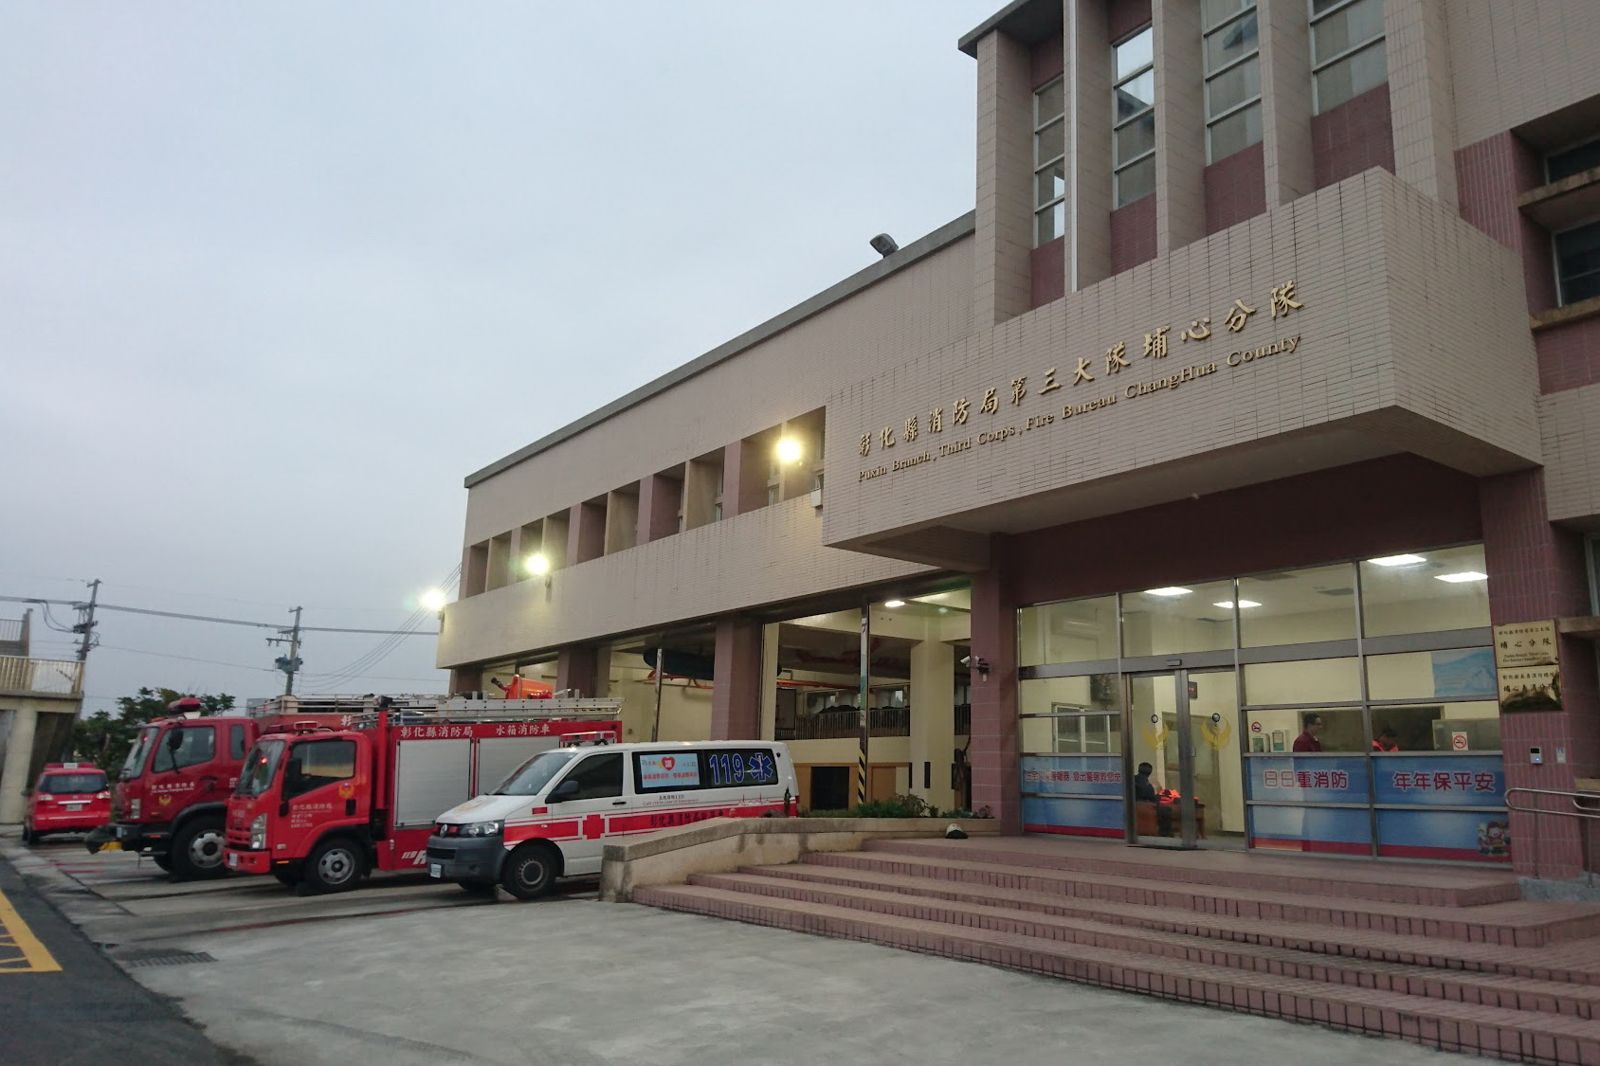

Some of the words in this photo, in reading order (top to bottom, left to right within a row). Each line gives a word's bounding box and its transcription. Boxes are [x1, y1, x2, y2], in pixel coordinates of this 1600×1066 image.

[859, 279, 1304, 457] 彰化縣消防局第三大隊埔心分隊
[859, 465, 888, 483] Puxin
[939, 437, 972, 457] Third
[1026, 413, 1055, 431] Fire
[1061, 394, 1118, 420] Bureau
[1124, 360, 1218, 399] ChangHua
[1226, 333, 1301, 369] County
[400, 725, 473, 738] 彰化縣消防局
[496, 722, 550, 736] 水箱消防車
[709, 753, 745, 785] 119
[1263, 769, 1349, 790] 日日重消防
[1393, 771, 1496, 794] 年年保平安
